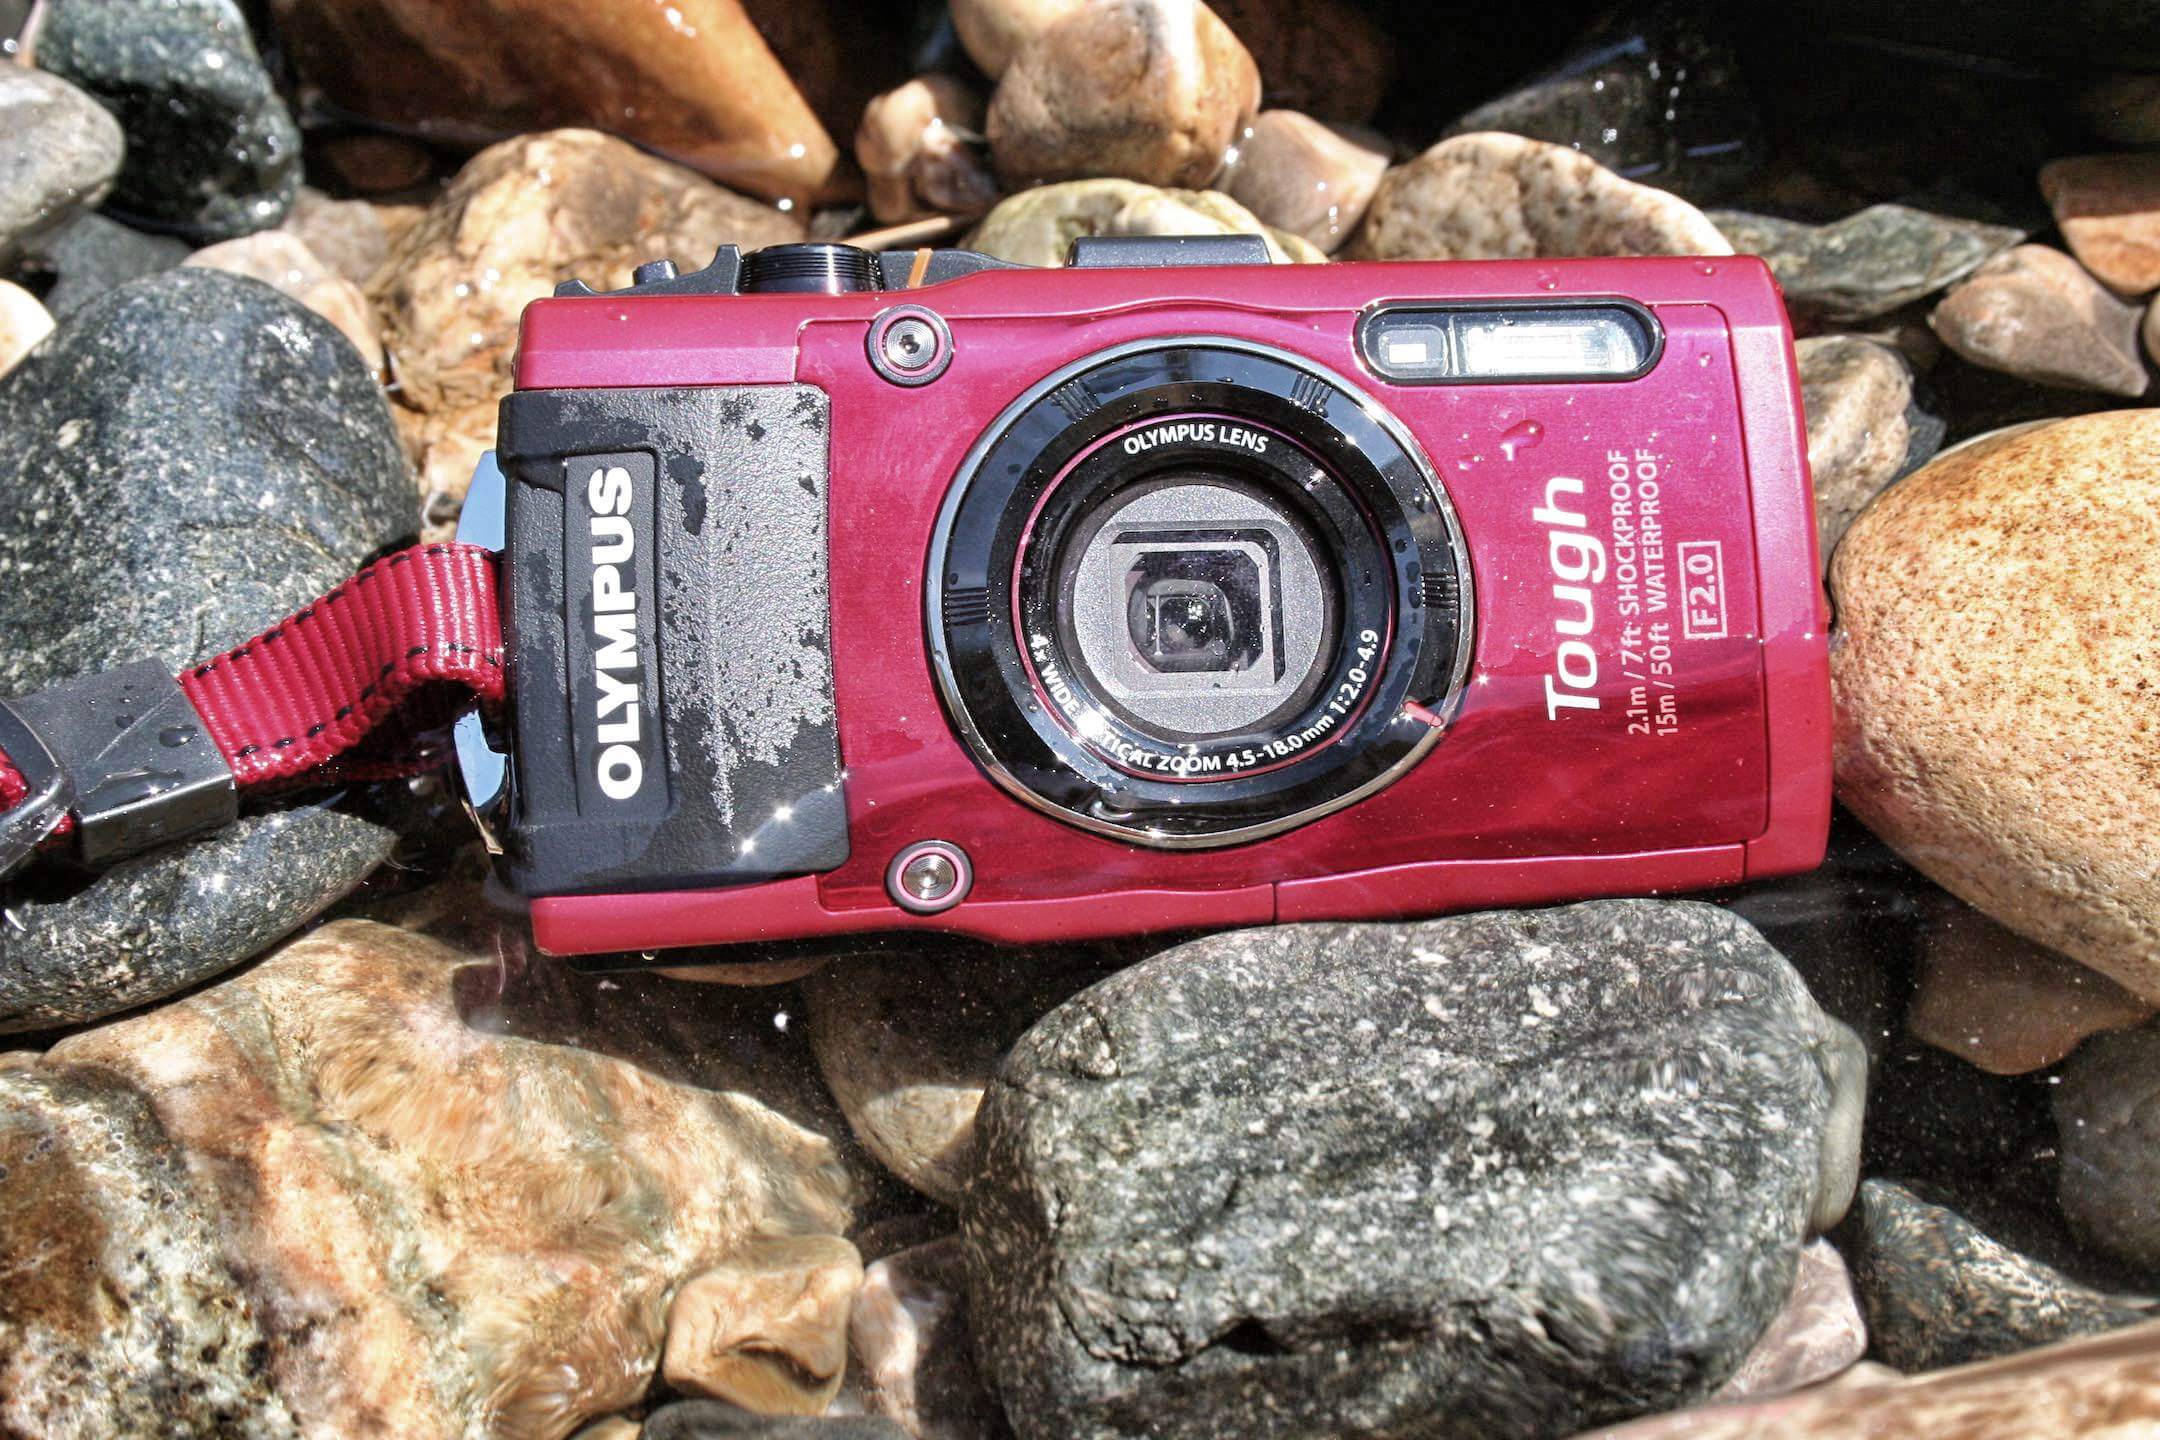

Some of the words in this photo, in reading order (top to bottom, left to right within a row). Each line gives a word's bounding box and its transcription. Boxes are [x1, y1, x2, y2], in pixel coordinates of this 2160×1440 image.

[1123, 424, 1215, 454] OLYMPUS
[1219, 426, 1269, 453] LENS
[1532, 476, 1606, 721] Tough
[1607, 450, 1641, 617] SHOCKPROOF
[1634, 448, 1669, 613] WATERPROOF
[1686, 554, 1718, 627] F2.0
[588, 466, 643, 800] OLYMPUS
[1041, 663, 1080, 721] WIDE
[1156, 755, 1221, 773] ZOOM
[1329, 629, 1379, 715] 1:2.0-4.9
